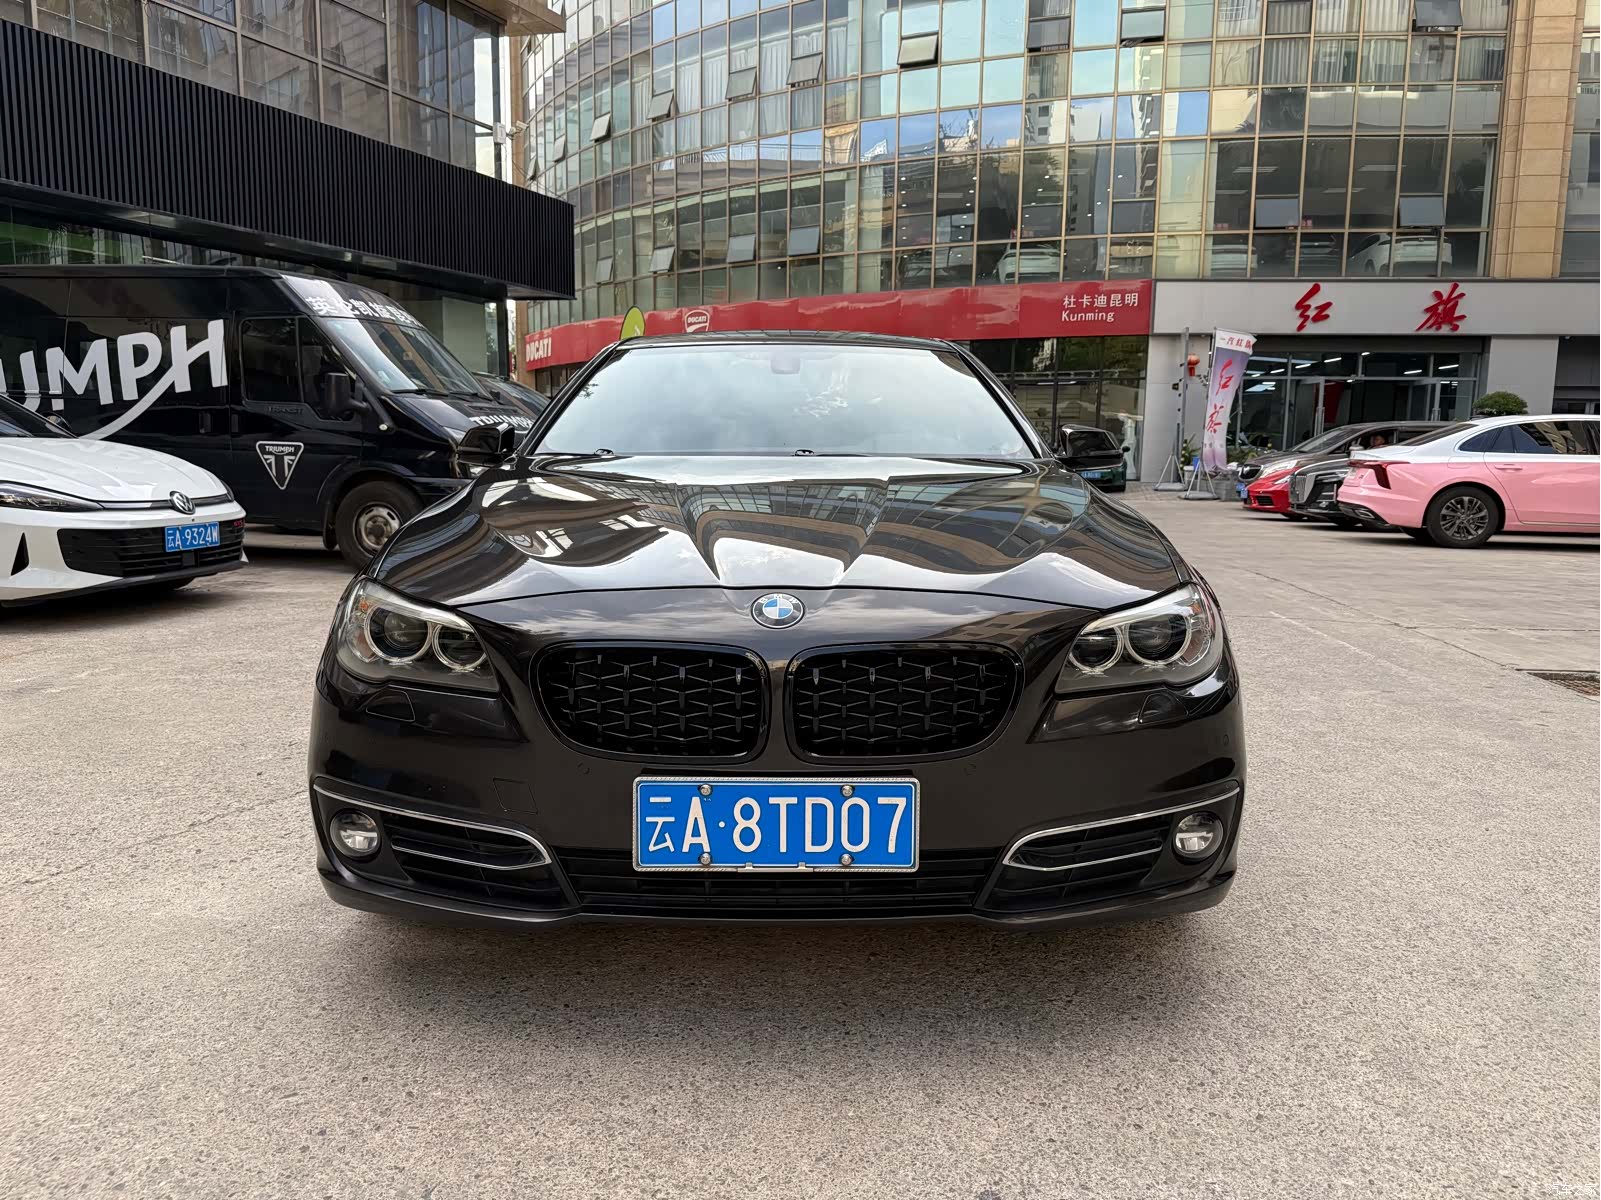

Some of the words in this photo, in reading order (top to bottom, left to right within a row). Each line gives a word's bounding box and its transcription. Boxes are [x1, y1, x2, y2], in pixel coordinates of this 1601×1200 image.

[1063, 293, 1138, 308] 杜卡迪昆明
[687, 315, 707, 324] DUCATI
[1061, 310, 1115, 322] Kunming
[526, 337, 552, 362] DUCATI
[265, 445, 295, 455] TRIUMPH
